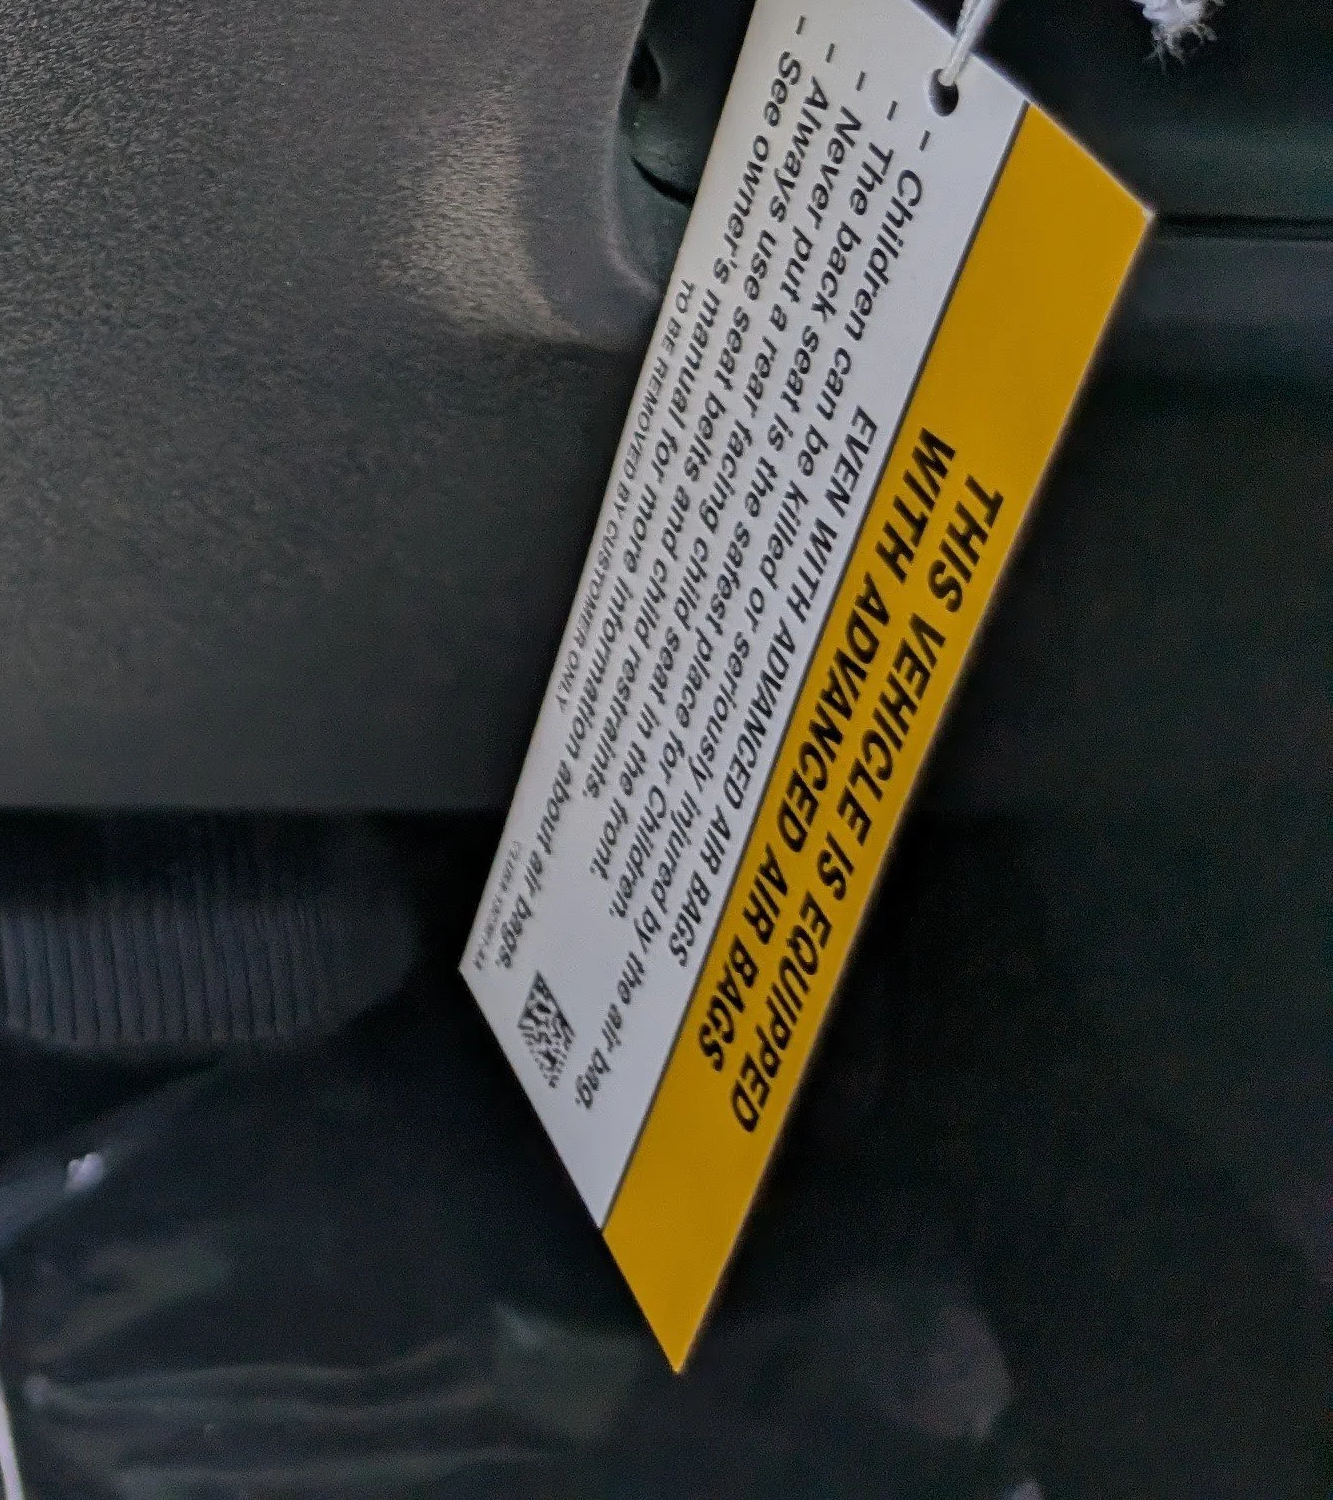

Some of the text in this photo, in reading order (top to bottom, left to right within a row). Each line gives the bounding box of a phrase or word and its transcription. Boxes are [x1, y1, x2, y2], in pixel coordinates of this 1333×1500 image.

[765, 51, 802, 127] See
[770, 76, 829, 222] Always
[807, 106, 862, 230] Never
[850, 143, 894, 215] The
[714, 135, 769, 284] owner's
[744, 230, 777, 301] use
[780, 226, 814, 303] put
[811, 222, 862, 322] back
[845, 170, 922, 341] Children
[669, 289, 721, 429] manual
[714, 306, 750, 391] seat
[769, 304, 788, 331] a
[743, 336, 777, 418] rear
[781, 325, 819, 413] seat
[817, 348, 852, 420] can
[651, 428, 678, 484] for
[685, 391, 727, 482] belts
[767, 413, 793, 451] is
[798, 424, 829, 476] be
[556, 280, 696, 710] TO BE REMOVED BY CUSTOMER ONLY
[699, 420, 753, 534] facing
[745, 457, 778, 517] the
[624, 484, 658, 573] more
[661, 485, 691, 561] and
[759, 480, 809, 590] killed
[634, 558, 667, 649] child
[674, 537, 709, 631] child
[705, 521, 750, 636] safest
[744, 587, 765, 633] or
[565, 576, 634, 760] information
[649, 626, 680, 705] seat
[669, 406, 877, 967] EVEN WITH ADVANCED AIR BAGS
[676, 627, 714, 728] place
[583, 645, 641, 798] restraints.
[637, 702, 661, 739] in
[688, 632, 750, 792] seriously
[699, 428, 955, 1071] WITH ADVANCED AIR BAGS
[620, 741, 647, 797] the
[659, 730, 685, 785] for
[537, 760, 572, 855] about
[590, 798, 629, 881] front.
[731, 475, 1004, 1132] THIS VEHICLE IS EQUIPPED
[524, 850, 544, 898] air
[609, 785, 666, 918] Children.
[651, 790, 702, 914] injured
[495, 895, 533, 969] bags.
[634, 906, 661, 954] by
[618, 952, 645, 1005] the
[602, 1003, 622, 1053] air
[576, 1048, 611, 1109] bag.
